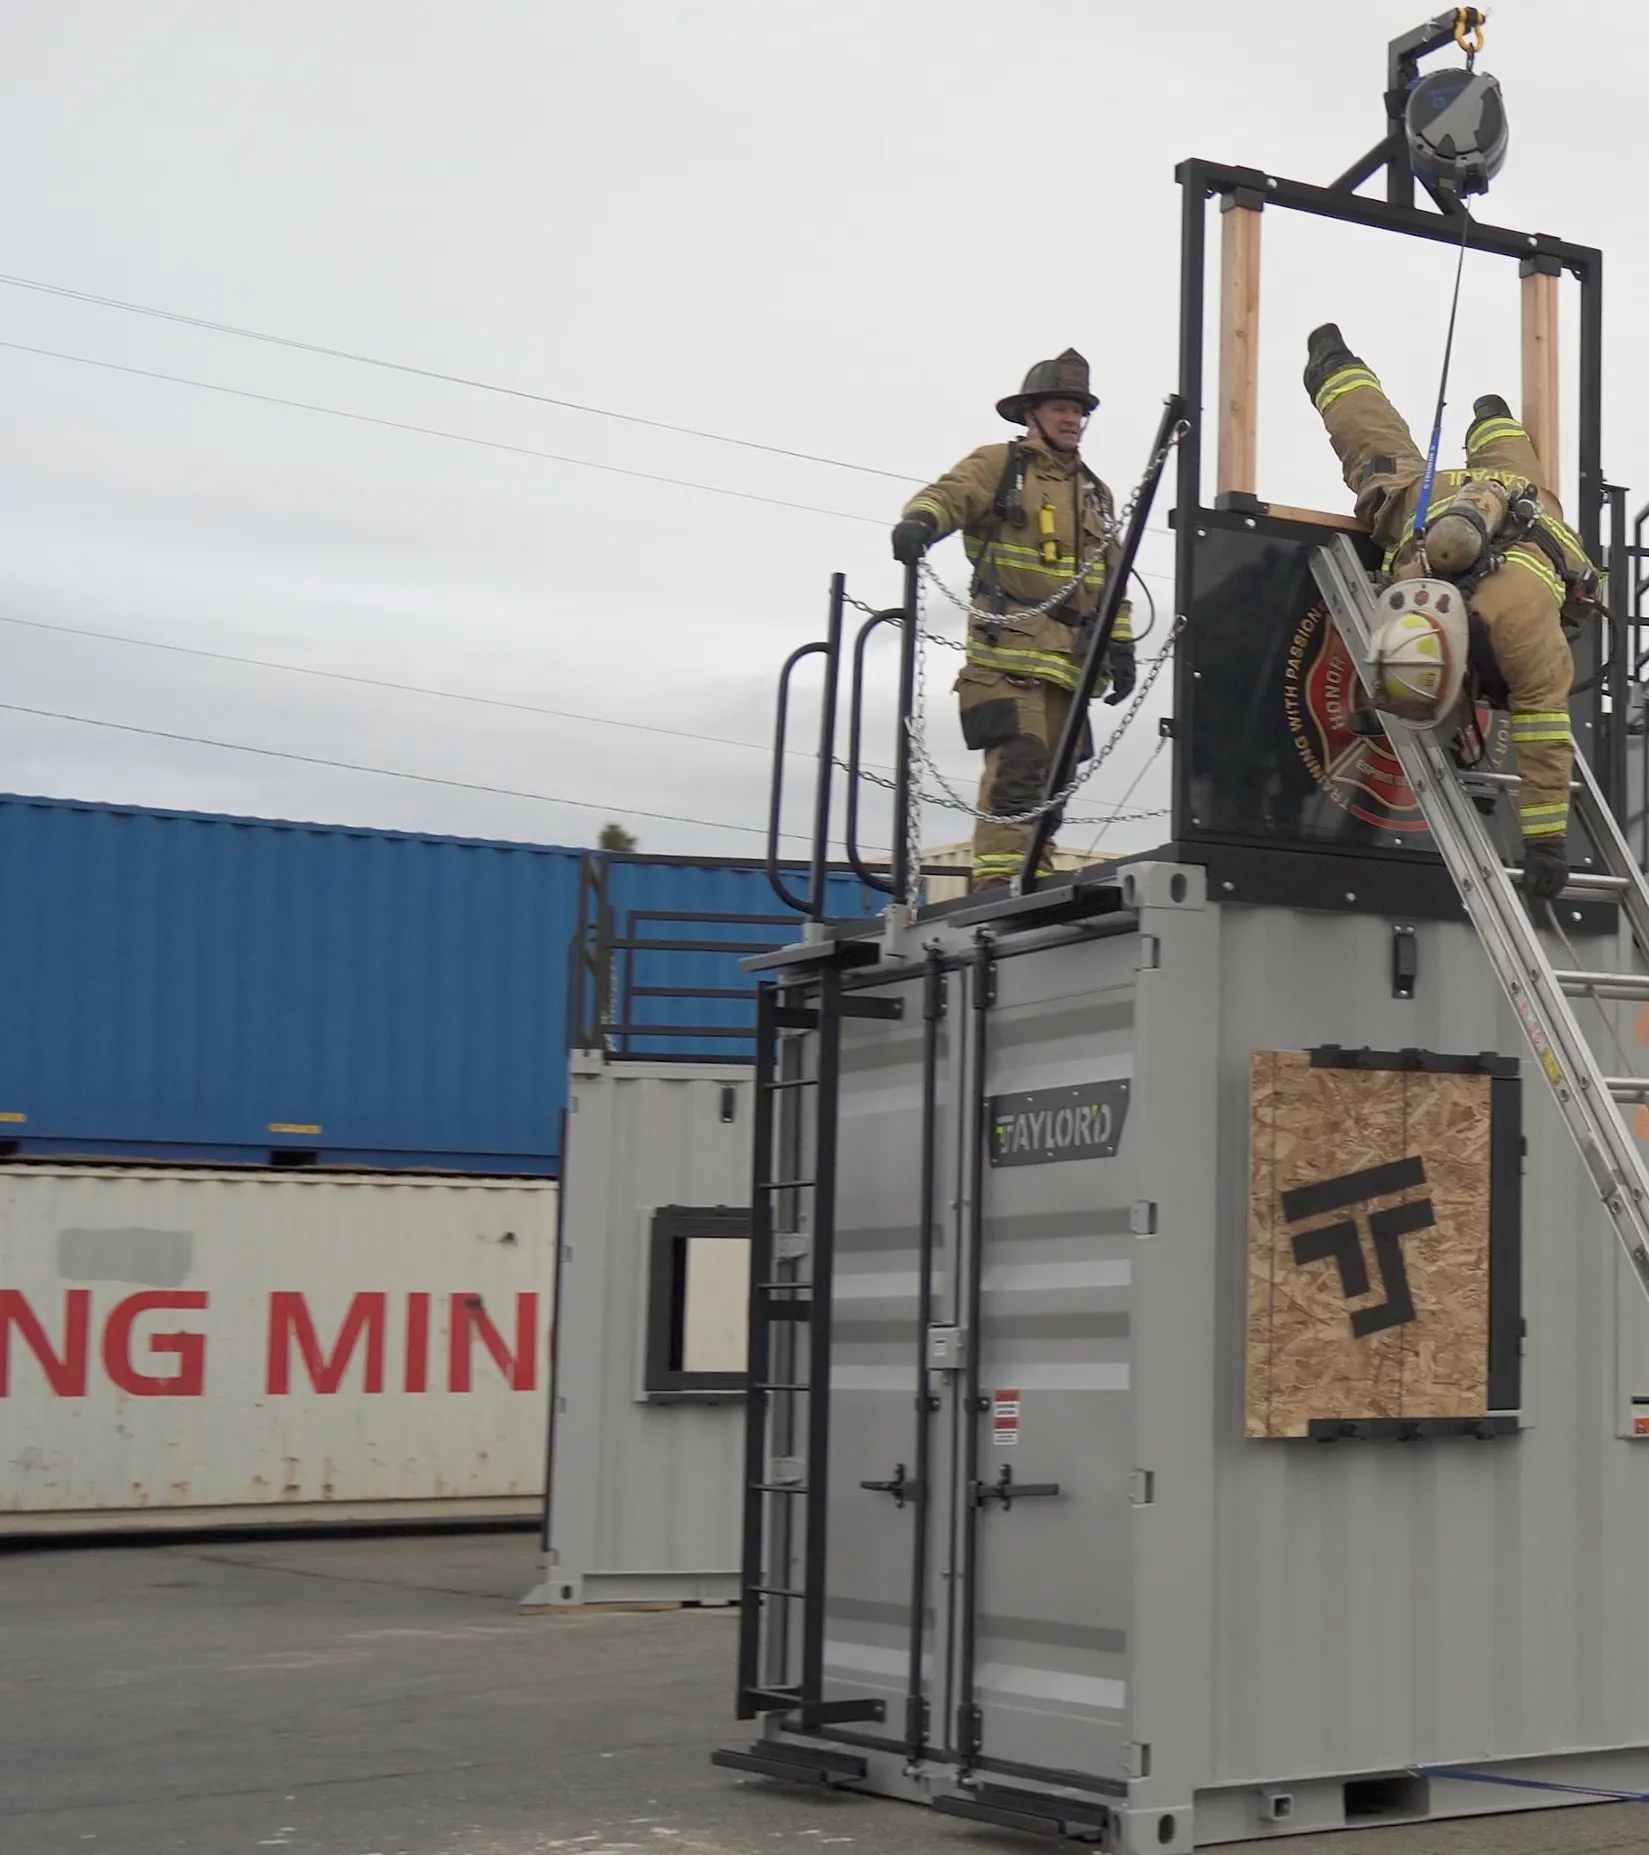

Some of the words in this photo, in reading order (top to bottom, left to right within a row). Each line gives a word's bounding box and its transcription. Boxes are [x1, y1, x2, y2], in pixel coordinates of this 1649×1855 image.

[1285, 606, 1322, 680] PASSION
[1284, 685, 1304, 732] WITH
[1295, 736, 1348, 811] TRAINING
[265, 1291, 554, 1396] MIN
